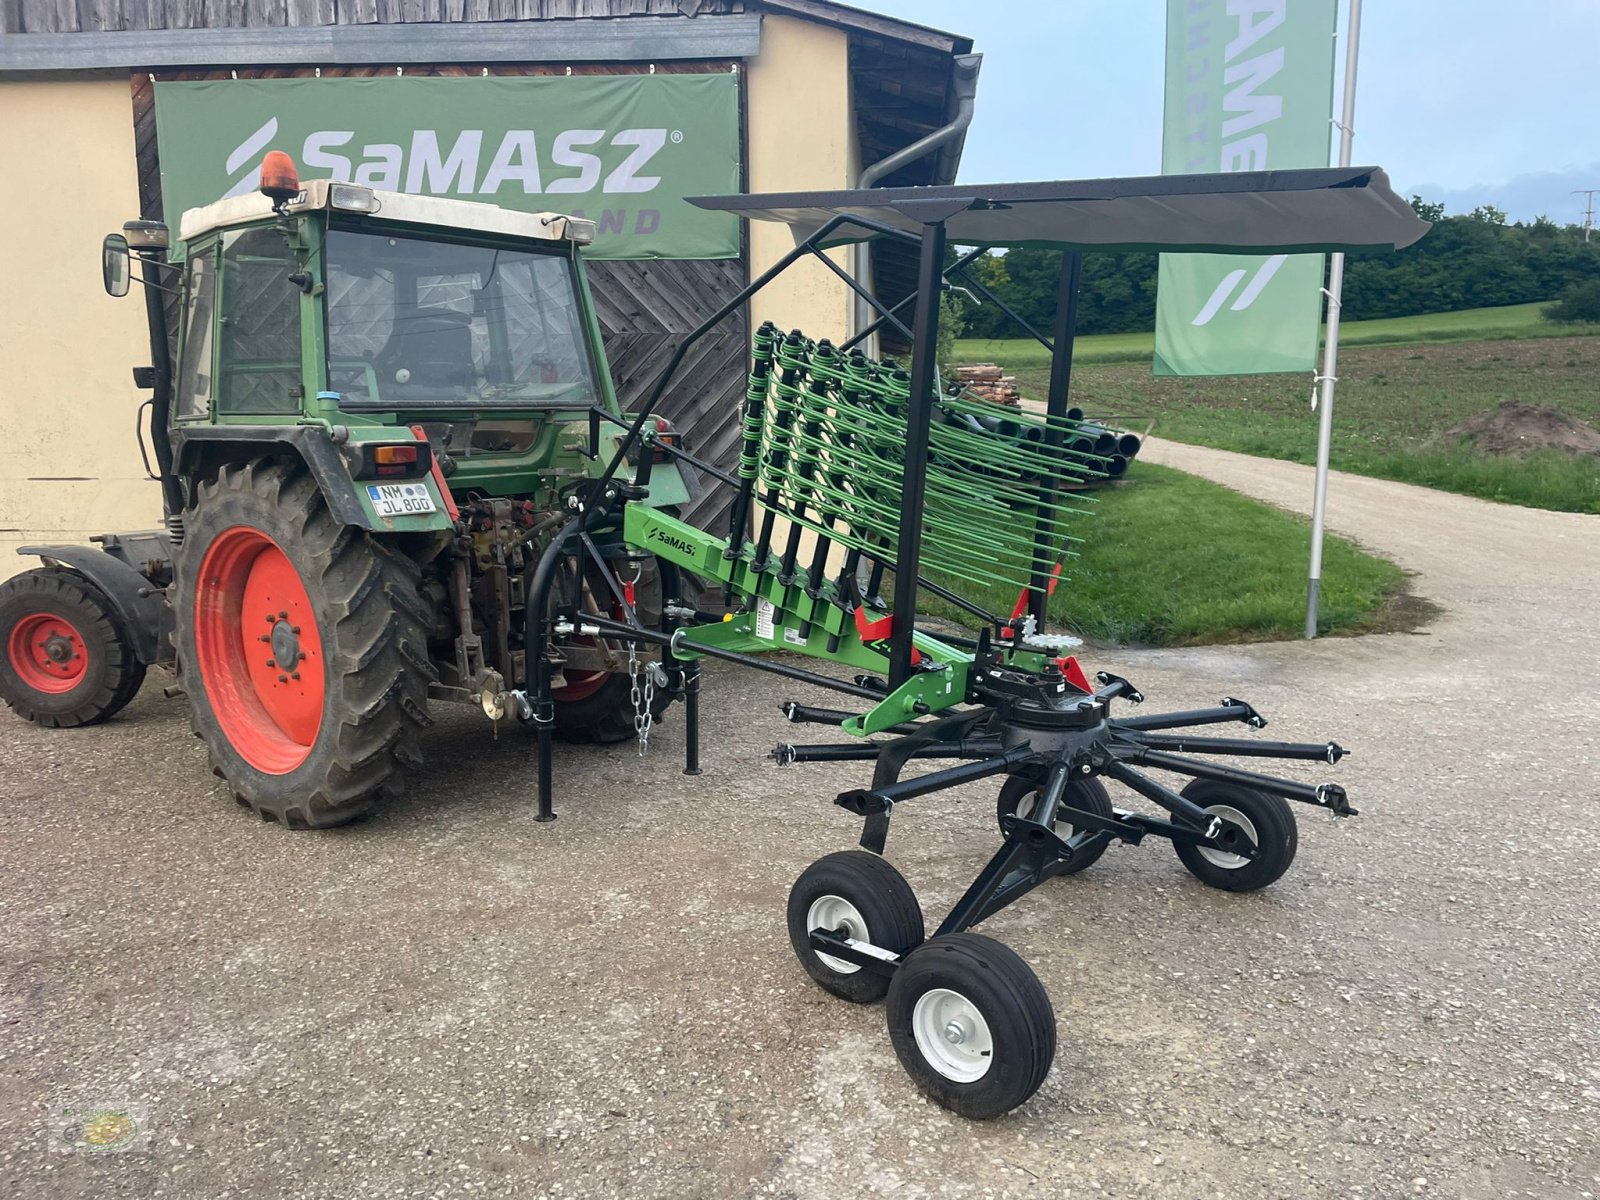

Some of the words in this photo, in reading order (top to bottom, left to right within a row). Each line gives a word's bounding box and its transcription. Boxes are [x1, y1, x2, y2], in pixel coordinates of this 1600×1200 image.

[381, 486, 403, 499] NM
[383, 500, 403, 514] JL
[403, 498, 430, 512] 800
